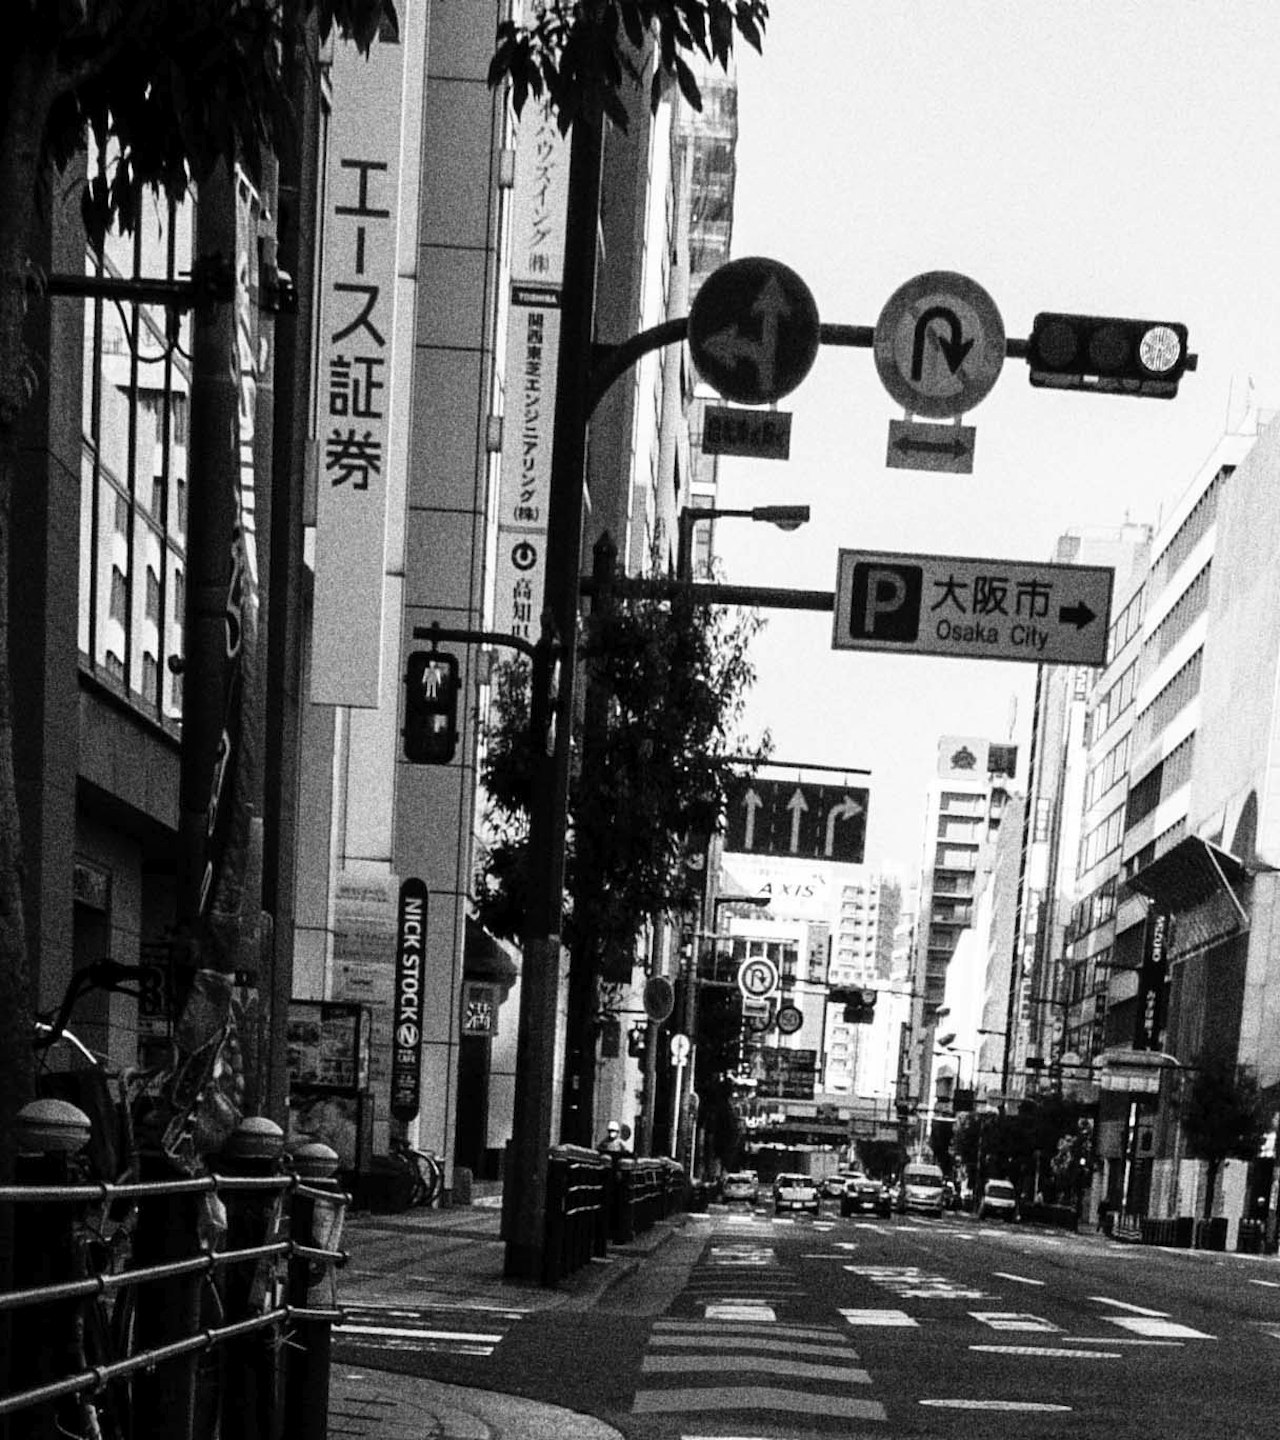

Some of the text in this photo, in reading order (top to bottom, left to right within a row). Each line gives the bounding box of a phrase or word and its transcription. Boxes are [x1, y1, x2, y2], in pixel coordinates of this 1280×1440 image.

[325, 159, 389, 491] エース証券
[931, 574, 1054, 619] 大阪市
[936, 619, 1049, 651] Osaka City
[757, 882, 816, 898] AXIS
[400, 897, 423, 1021] NICK STOCK
